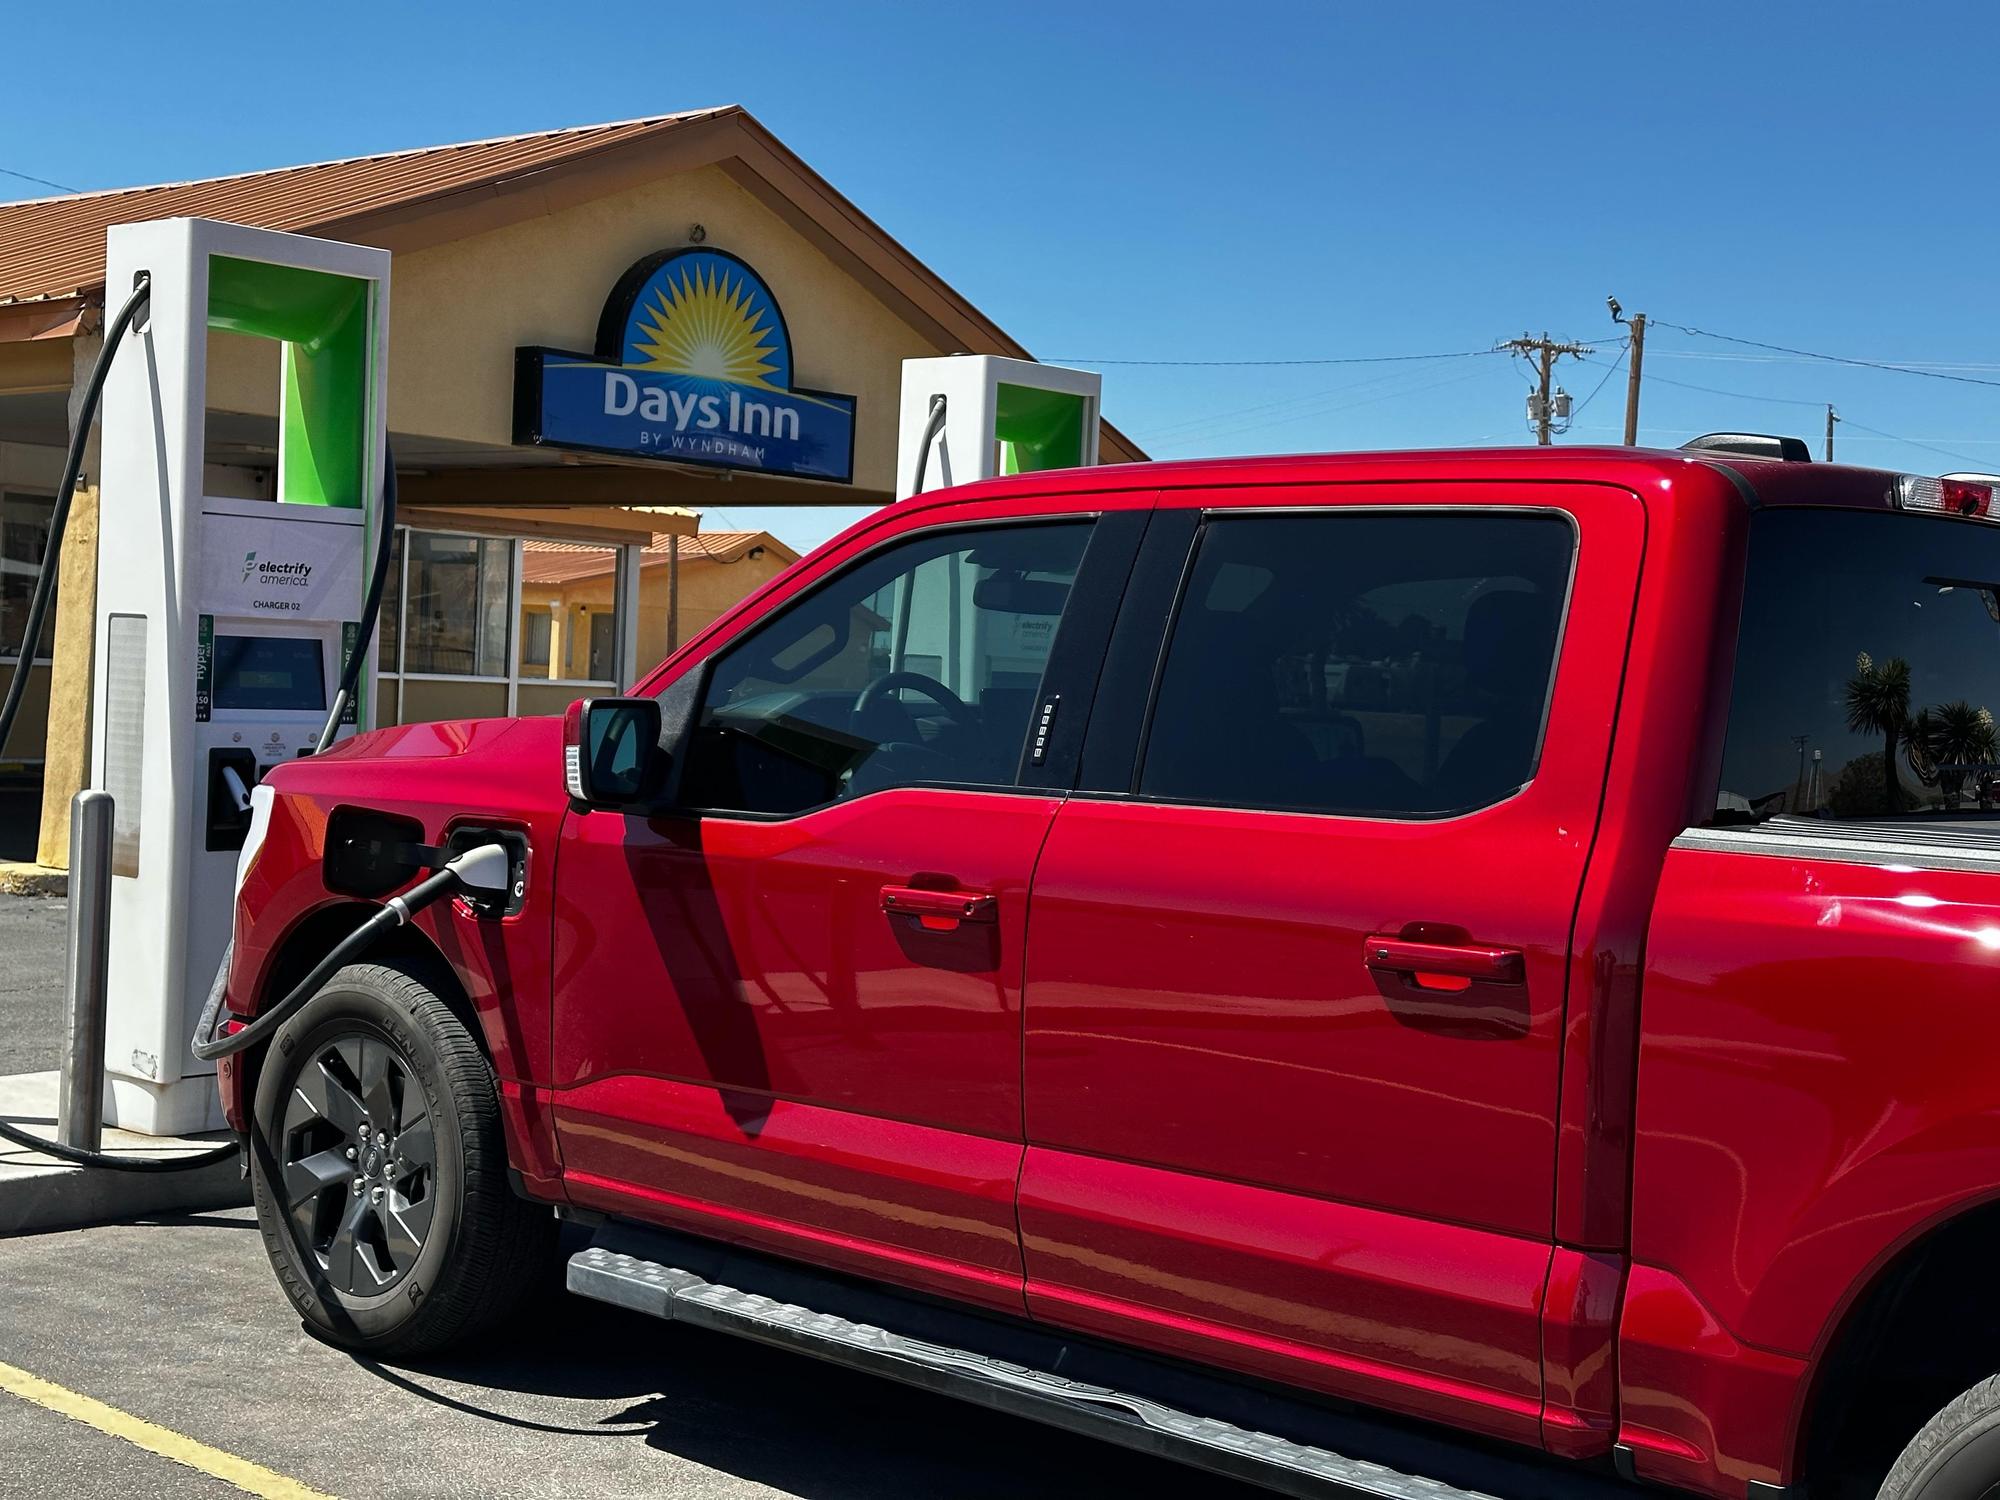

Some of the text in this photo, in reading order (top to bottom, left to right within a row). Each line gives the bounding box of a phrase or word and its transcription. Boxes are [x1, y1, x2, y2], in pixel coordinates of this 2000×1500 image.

[604, 371, 800, 441] Days Inn
[640, 431, 765, 459] BY WYNDHAM
[259, 561, 312, 577] electrify
[260, 575, 308, 587] america
[253, 600, 301, 611] CHARGER 02
